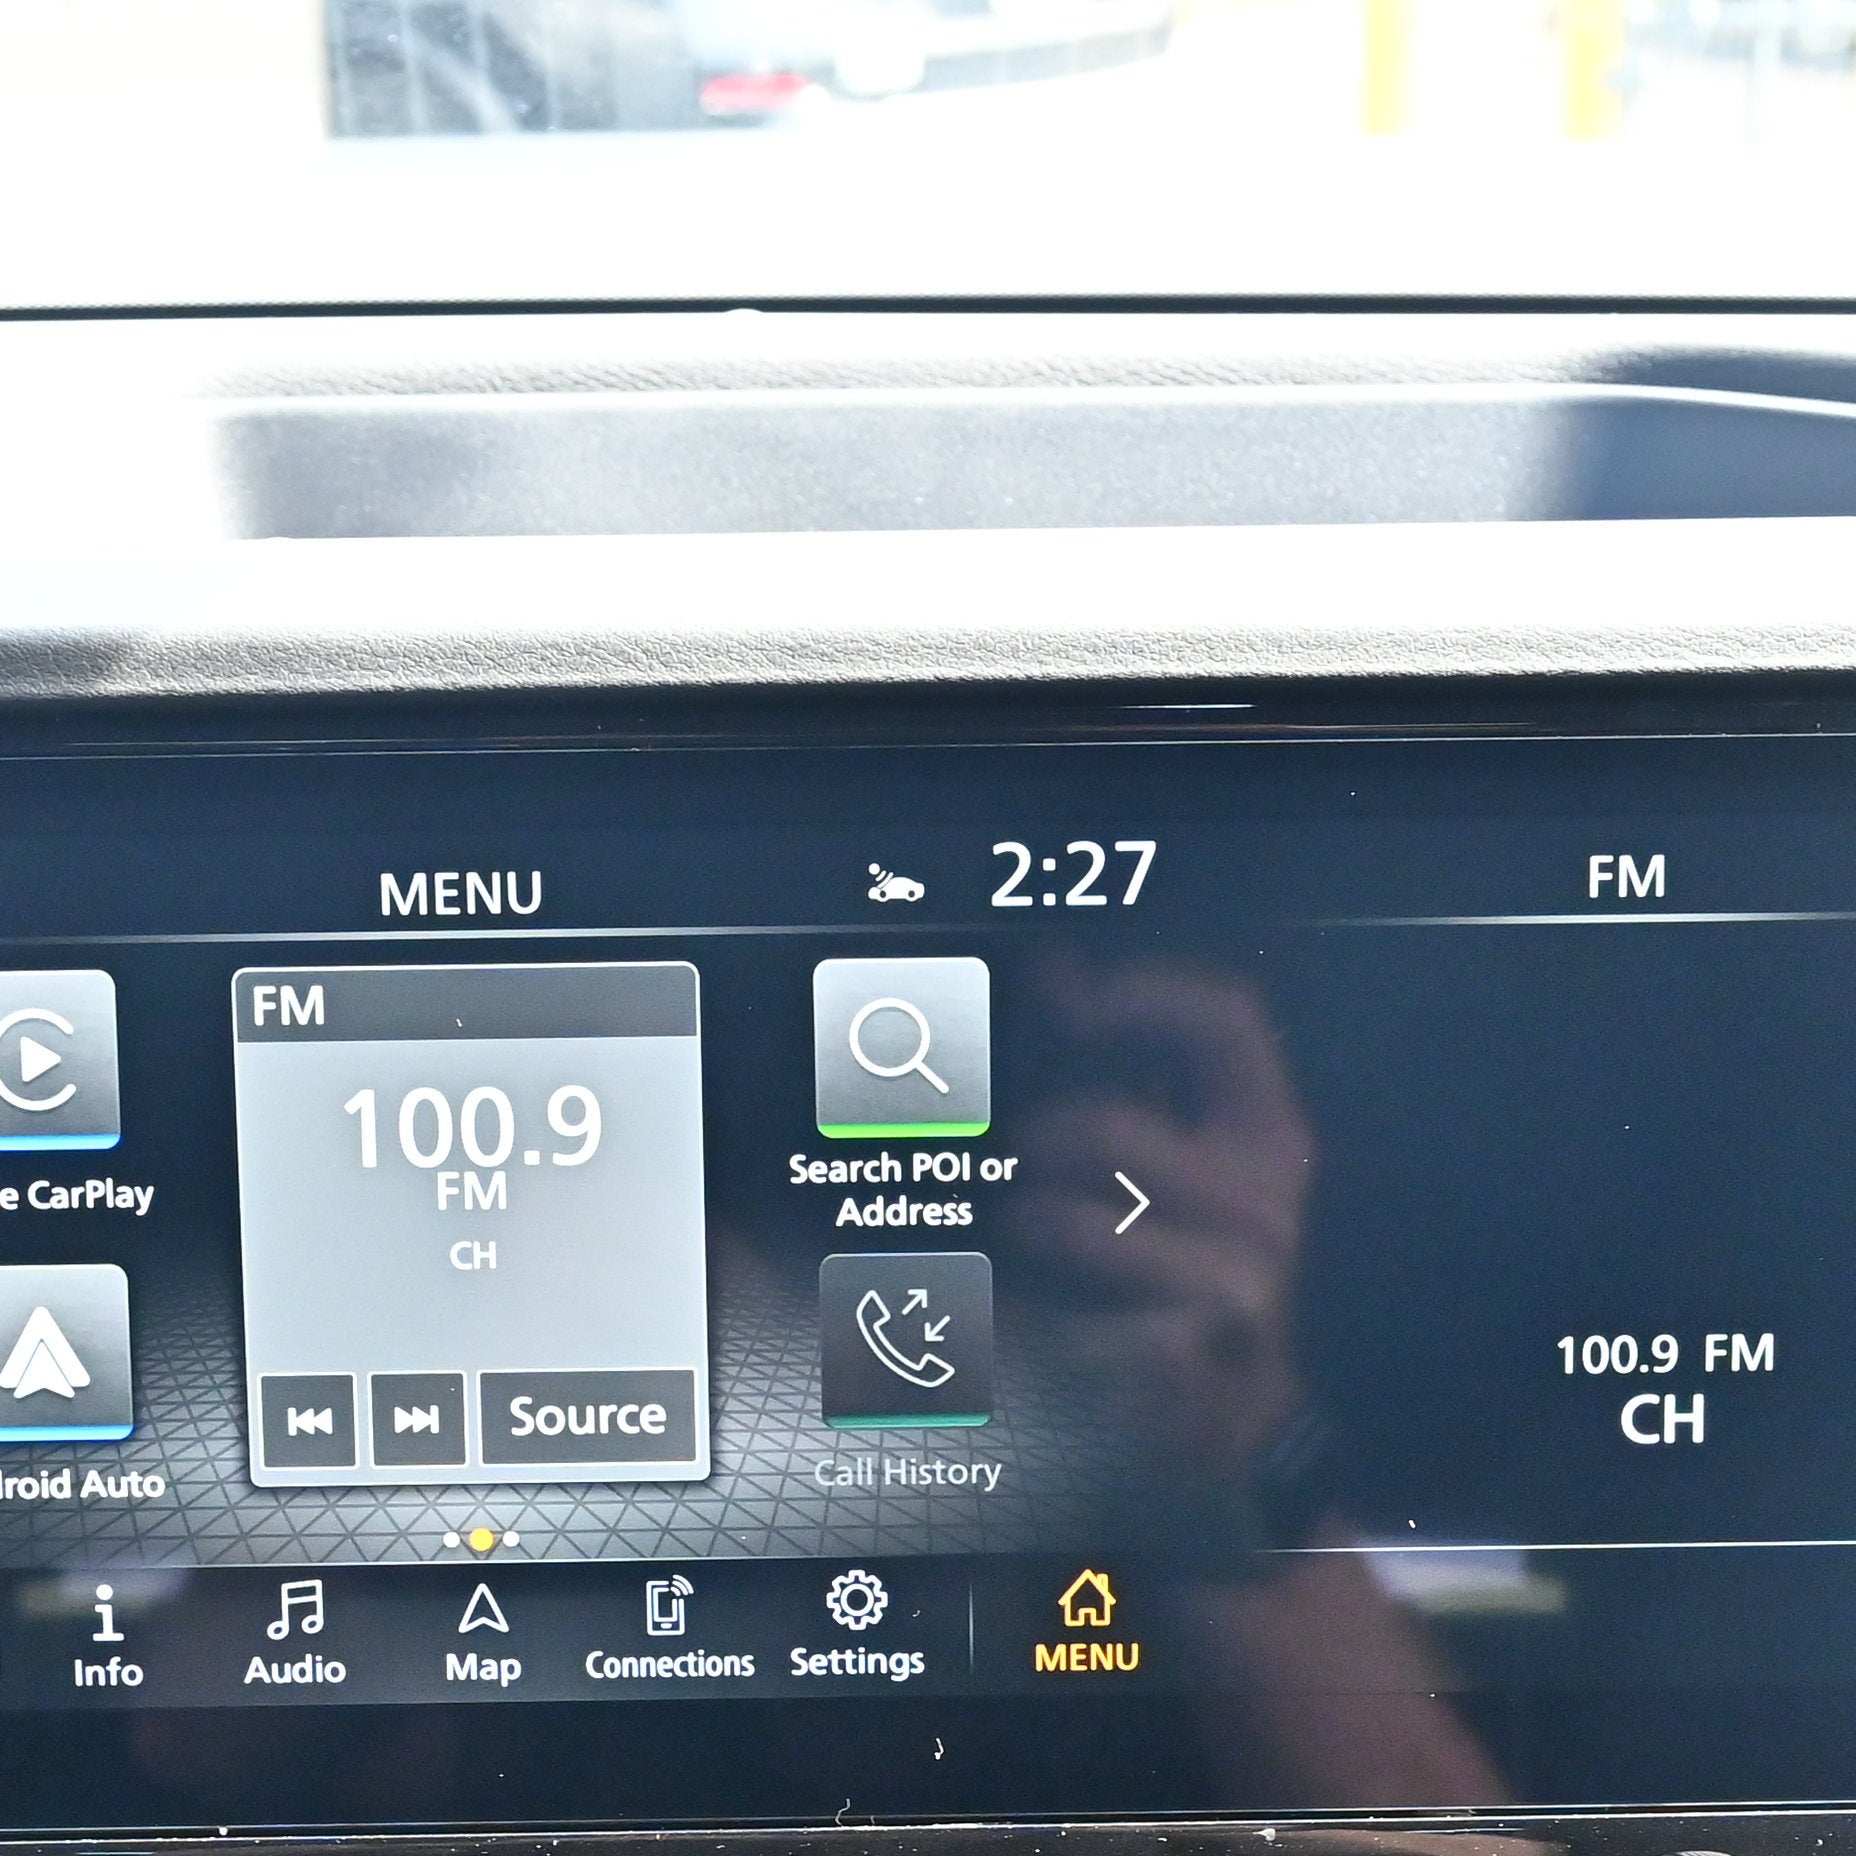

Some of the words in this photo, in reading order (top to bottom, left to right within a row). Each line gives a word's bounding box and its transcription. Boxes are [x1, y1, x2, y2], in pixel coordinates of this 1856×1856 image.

[991, 840, 1156, 907] 2:27
[1587, 854, 1666, 898] FM
[380, 870, 542, 916] MENU
[253, 984, 325, 1026] FM
[343, 1084, 603, 1168] 100.9
[789, 1152, 902, 1184] Search
[913, 1152, 970, 1182] POI
[979, 1157, 1019, 1181] or
[27, 1177, 155, 1216] CarPlay
[437, 1170, 507, 1211] FM
[835, 1195, 973, 1227] Address
[449, 1240, 497, 1270] CH
[1556, 1334, 1679, 1374] 100.9
[1704, 1333, 1775, 1373] FM
[510, 1396, 667, 1437] Source
[1620, 1393, 1706, 1445] CH
[80, 1469, 166, 1499] Auto
[814, 1458, 873, 1487] Call
[884, 1457, 1003, 1492] History
[74, 1657, 144, 1687] Info
[244, 1653, 347, 1685] Audio
[445, 1652, 522, 1688] Map
[585, 1647, 756, 1681] Connections
[790, 1647, 925, 1682] Settings
[1034, 1643, 1140, 1672] MENU
